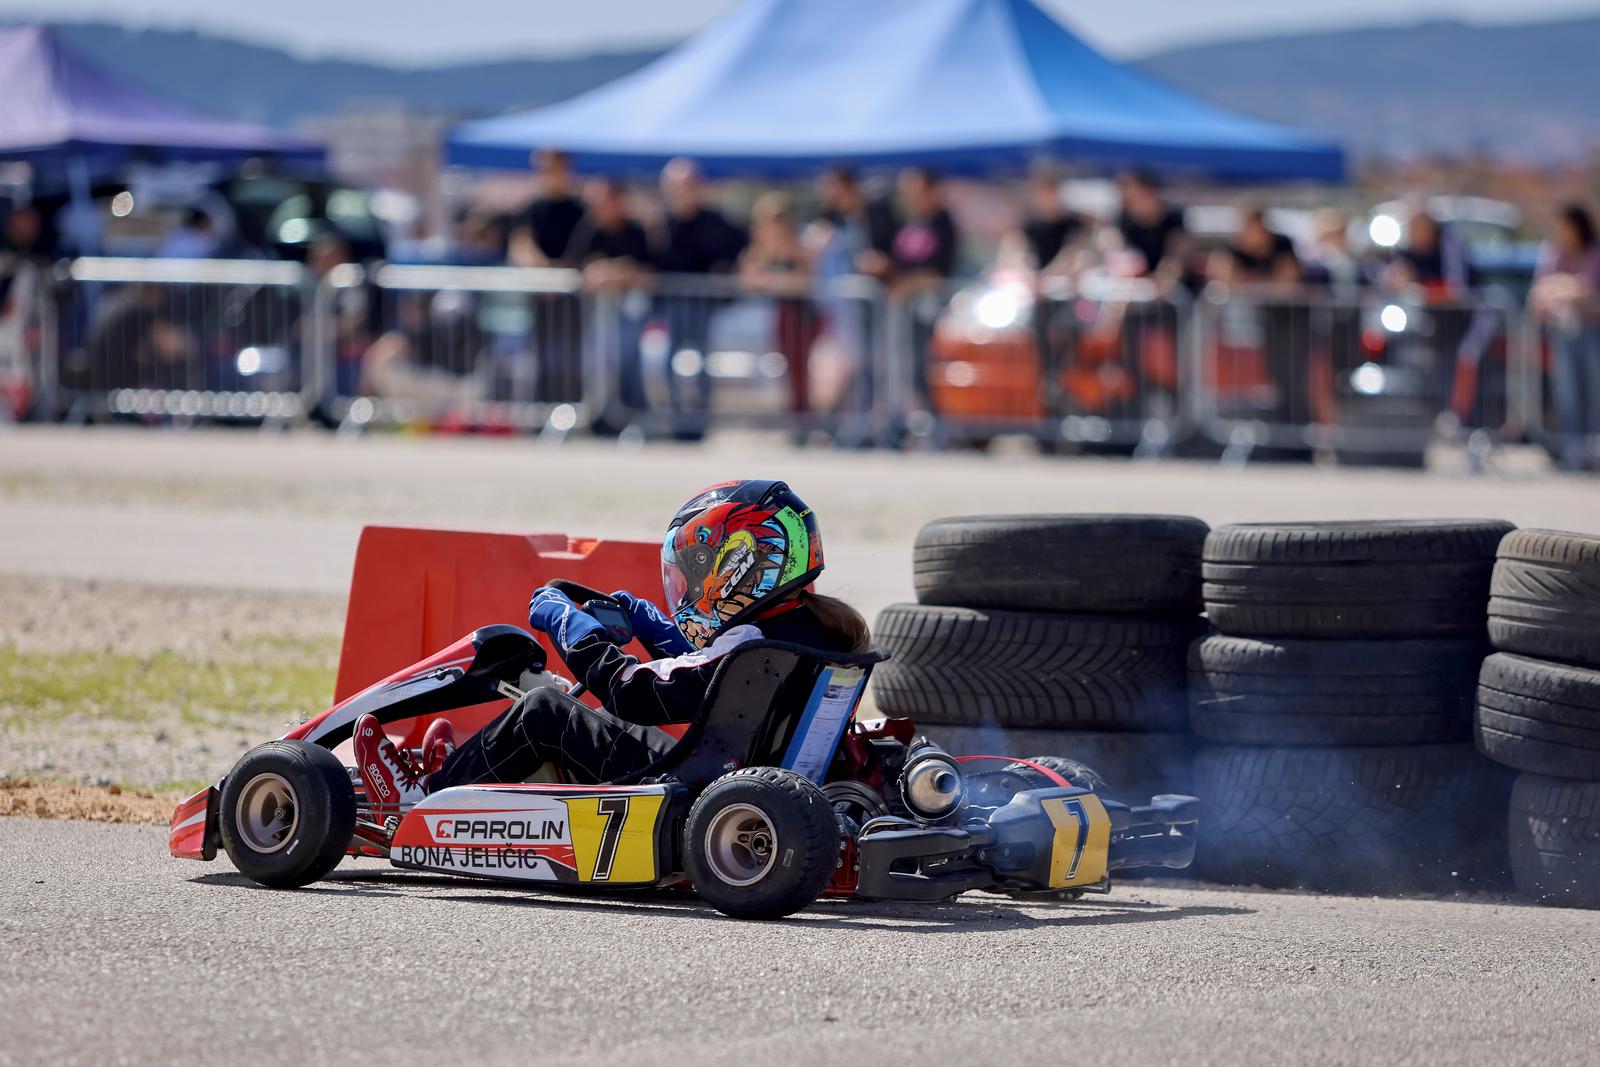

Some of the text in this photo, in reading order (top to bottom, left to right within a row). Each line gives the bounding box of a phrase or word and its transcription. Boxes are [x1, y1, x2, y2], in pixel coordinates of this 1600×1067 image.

[369, 763, 391, 797] sparco
[453, 820, 564, 840] PAROLIN
[591, 796, 630, 881] 7
[1062, 799, 1090, 880] 7
[401, 843, 538, 870] BONA JELIČIC
